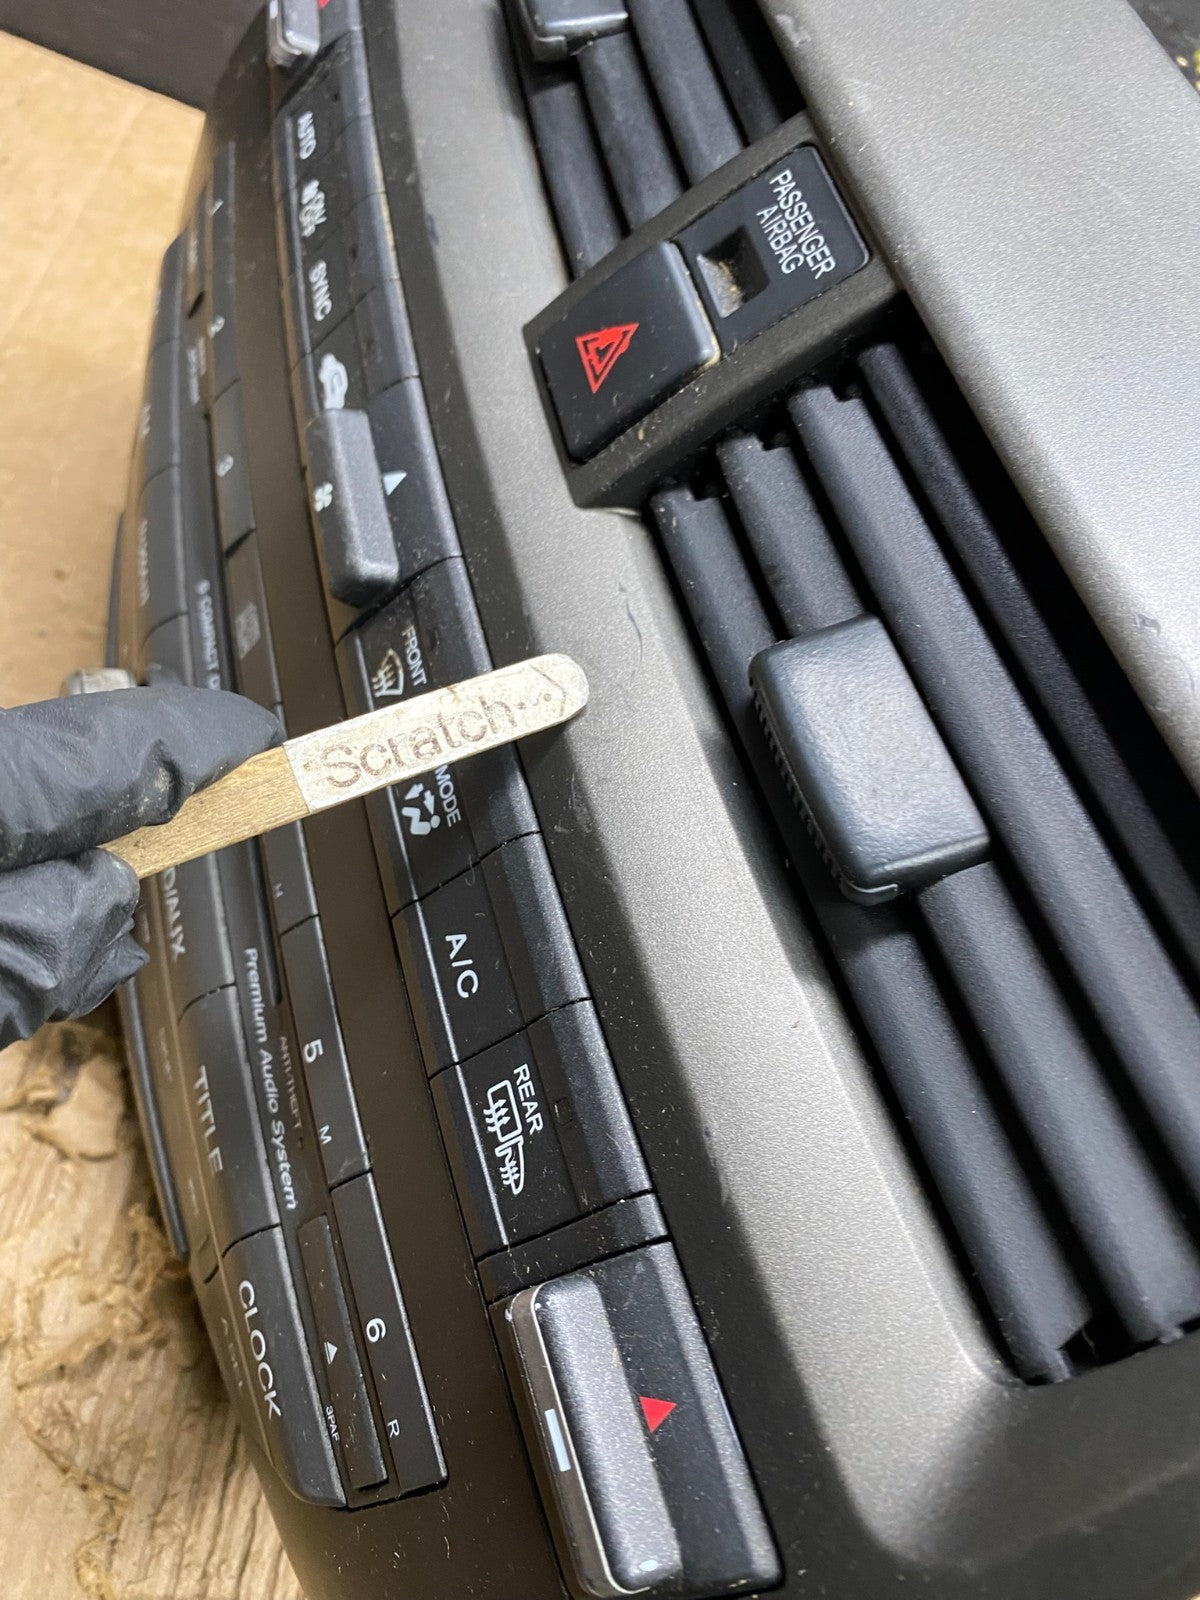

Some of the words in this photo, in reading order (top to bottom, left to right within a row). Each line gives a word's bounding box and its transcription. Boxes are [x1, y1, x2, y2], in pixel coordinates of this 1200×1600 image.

[297, 111, 317, 160] AUTO
[756, 205, 804, 274] AIRBAG
[769, 169, 836, 279] PASSENGER
[308, 259, 332, 321] SYNC
[401, 624, 428, 687] FRONT
[319, 695, 519, 789] Scratch
[434, 763, 462, 827] MODE
[164, 866, 186, 962] D/AUX
[445, 933, 479, 998] A/C
[244, 948, 268, 1043] Premium
[260, 1049, 279, 1114] Audio
[271, 1119, 298, 1210] System
[304, 1038, 324, 1063] 5
[193, 1064, 223, 1177] TITLE
[513, 1063, 544, 1135] REAR
[319, 1123, 332, 1145] M
[238, 1279, 282, 1420] CLOCK
[366, 1317, 387, 1343] 6
[324, 1404, 341, 1442] 3PAF
[386, 1418, 400, 1438] R
